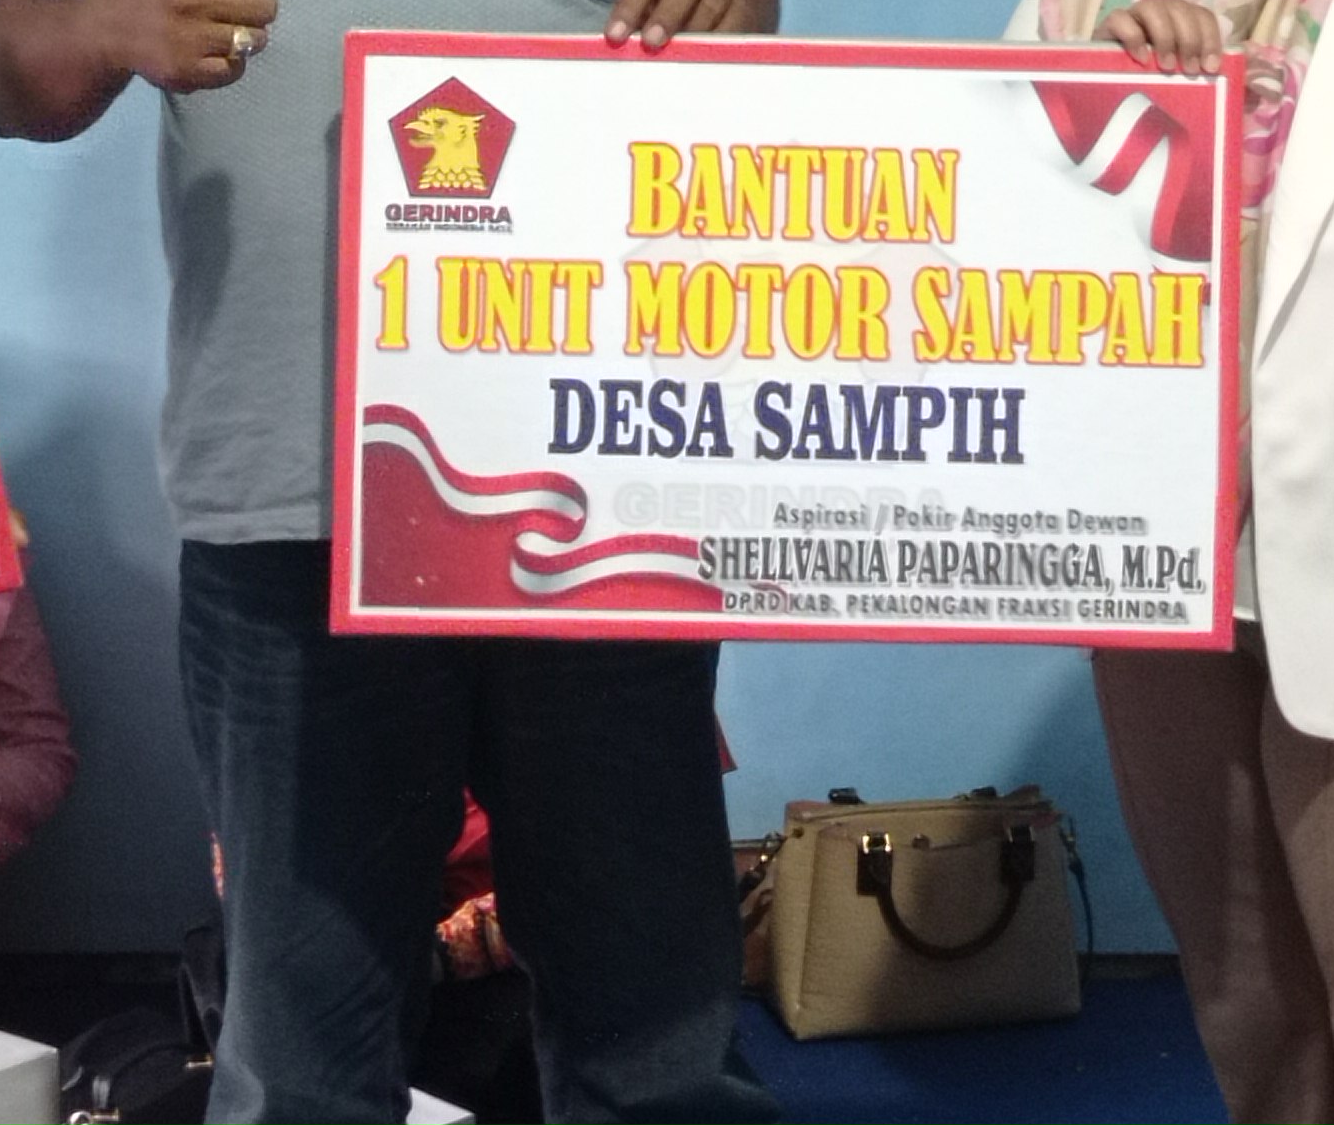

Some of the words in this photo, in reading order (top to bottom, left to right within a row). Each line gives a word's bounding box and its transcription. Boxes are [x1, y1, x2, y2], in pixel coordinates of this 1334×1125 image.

[384, 203, 513, 224] GERINDRA
[628, 141, 961, 244] BANTUAN
[374, 255, 409, 352] 1
[436, 257, 603, 355] UNIT
[624, 261, 891, 361] MOTOR
[912, 267, 1207, 368] SAMPAH
[547, 377, 734, 459] DESA
[753, 380, 1027, 465] SAMPIH
[772, 502, 870, 532] Aspirasi
[960, 507, 1062, 535] Anggota
[1067, 509, 1148, 533] Dewan
[896, 540, 1114, 593] PAPARINGGA,
[1120, 546, 1205, 591] M.Pd.
[724, 591, 782, 612] DPRD
[788, 593, 841, 612] KAB.
[847, 596, 989, 618] PEKALONGAN
[998, 598, 1072, 619] FRAKSI
[1077, 601, 1188, 621] GERINDRA
